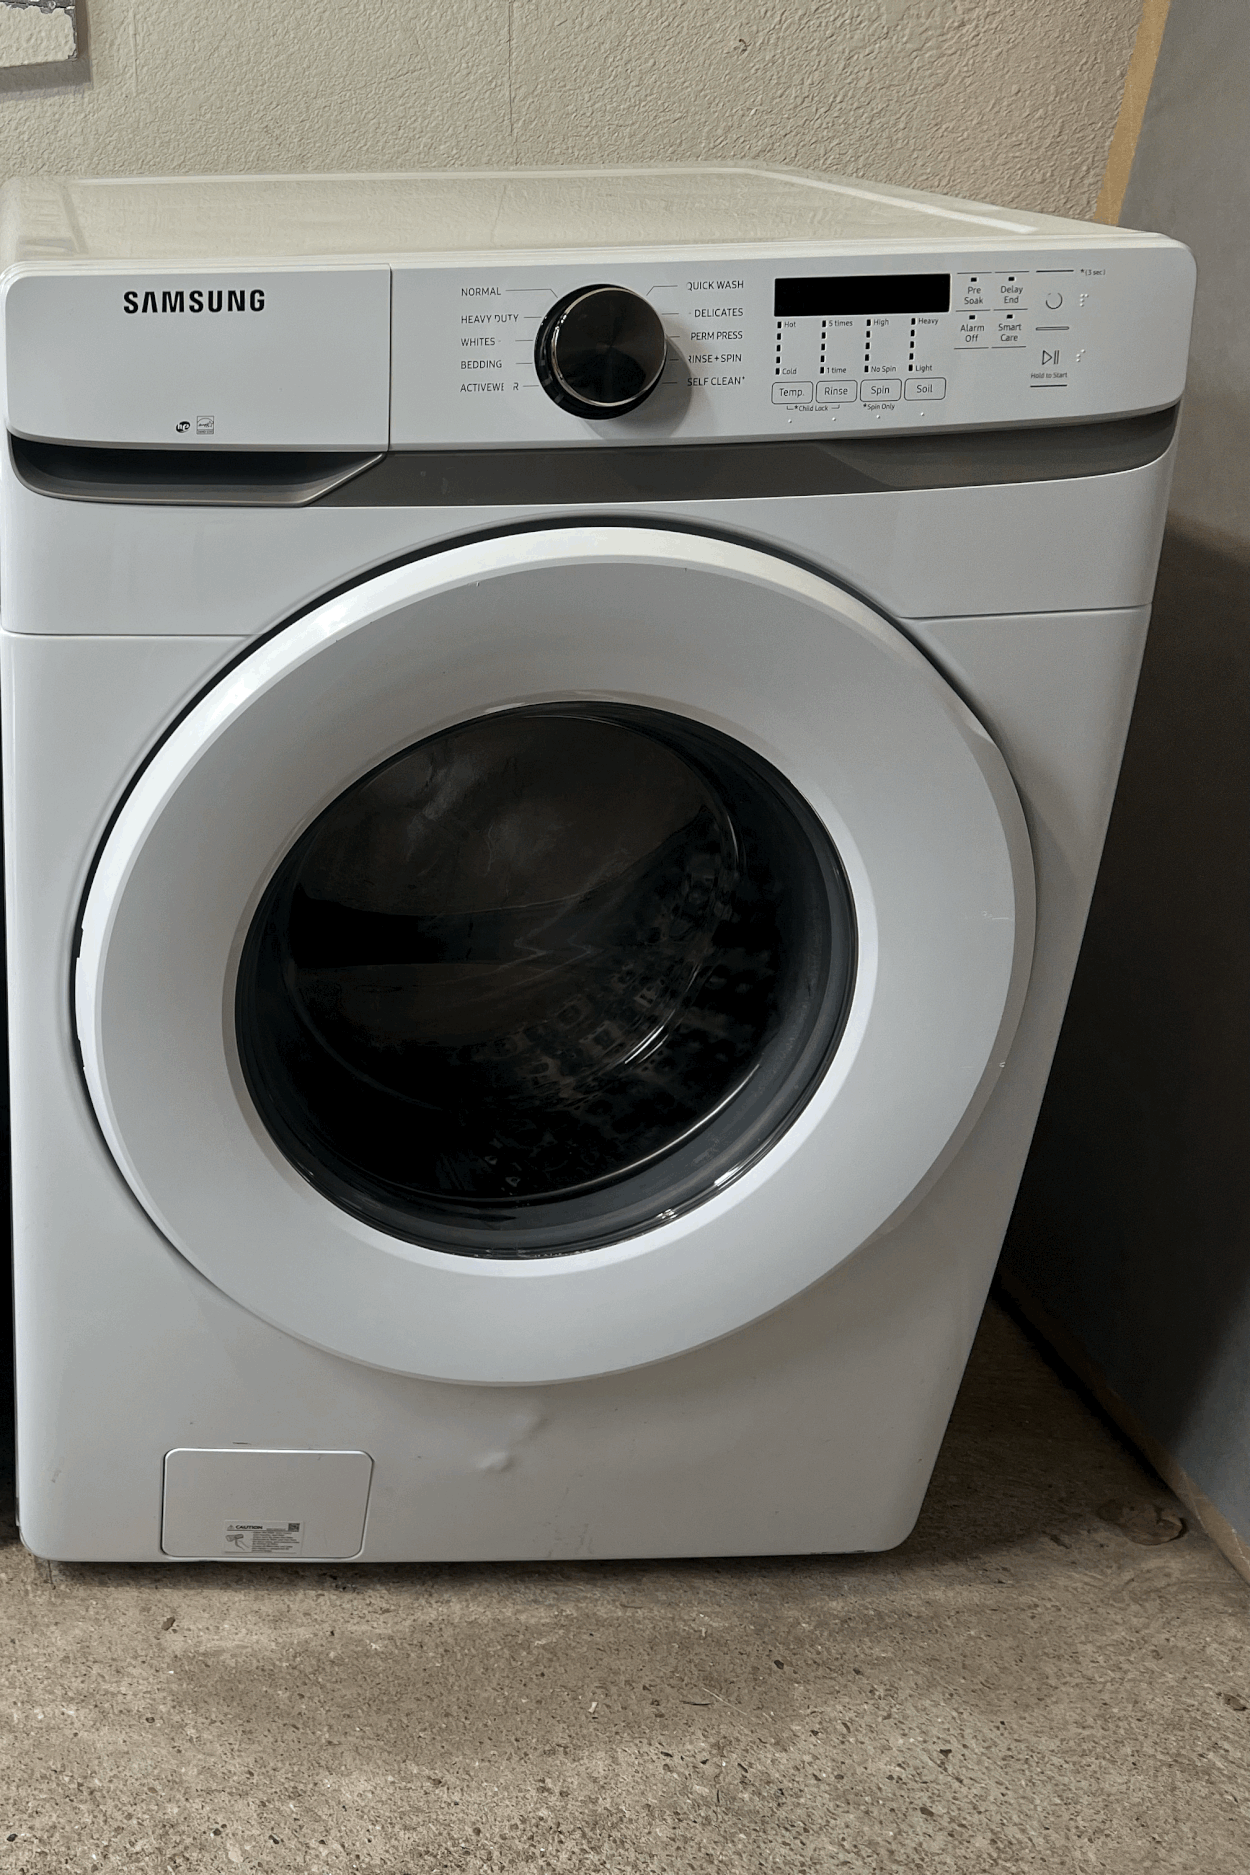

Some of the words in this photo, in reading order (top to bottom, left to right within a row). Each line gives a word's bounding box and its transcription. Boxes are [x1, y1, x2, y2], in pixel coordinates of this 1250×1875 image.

[686, 281, 714, 291] QUICK
[717, 280, 744, 289] WASH
[967, 286, 981, 294] Pre
[1000, 285, 1023, 295] Delay
[461, 287, 501, 297] NORMAL
[124, 289, 265, 314] SAMSUNG
[964, 296, 983, 305] Soak
[1004, 295, 1019, 304] End
[695, 307, 743, 318] DELICATES
[461, 315, 492, 324] HEAVY
[835, 319, 853, 327] times
[873, 318, 889, 327] High
[918, 317, 939, 326] Heavy
[960, 323, 985, 332] Alarm
[998, 322, 1022, 332] Smart
[691, 332, 714, 340] PERM
[716, 331, 742, 340] PRESS
[965, 333, 979, 343] Off
[1000, 333, 1018, 342] Care
[461, 337, 496, 346] WHITES
[721, 354, 741, 362] SPIN
[461, 360, 502, 369] BEDDING
[687, 377, 709, 386] SELF
[460, 382, 519, 393] ACTIVEWER
[824, 387, 848, 396] Rinse
[871, 385, 890, 396] Spin
[916, 384, 933, 394] Soil
[779, 388, 804, 398] Temp.
